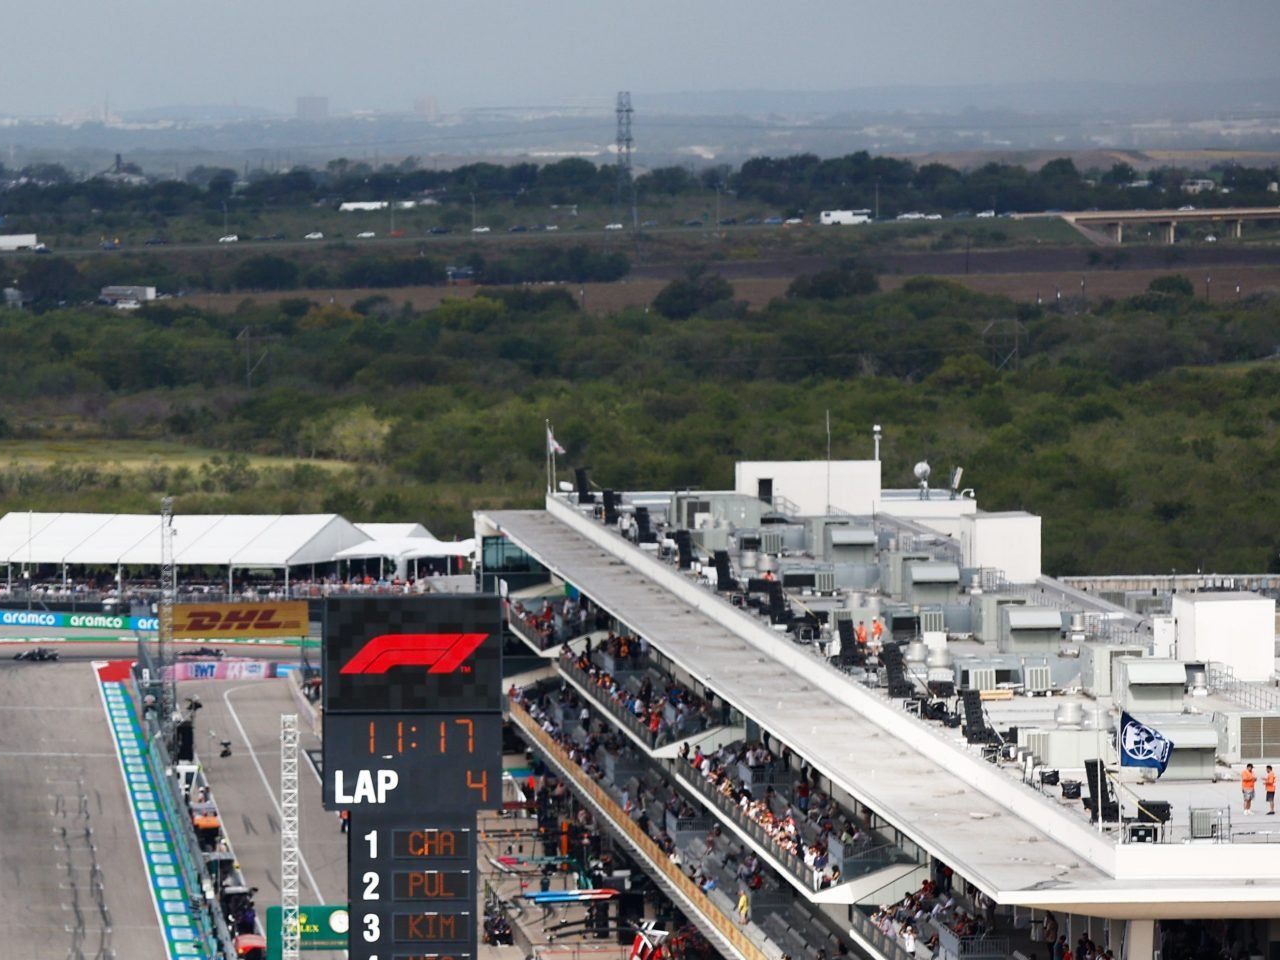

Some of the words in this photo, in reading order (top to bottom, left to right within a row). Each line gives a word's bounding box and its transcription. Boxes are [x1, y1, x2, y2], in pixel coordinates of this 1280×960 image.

[3, 612, 56, 625] aramco
[70, 615, 123, 628] aramco
[186, 609, 282, 631] DHL
[369, 719, 474, 753] 11:17
[335, 769, 399, 804] LAP
[467, 770, 488, 802] 4
[364, 830, 378, 859] 1
[408, 831, 455, 856] CHA
[362, 871, 380, 901] 2
[408, 873, 455, 897] PUL
[362, 913, 381, 942] 3
[408, 914, 455, 939] KIM
